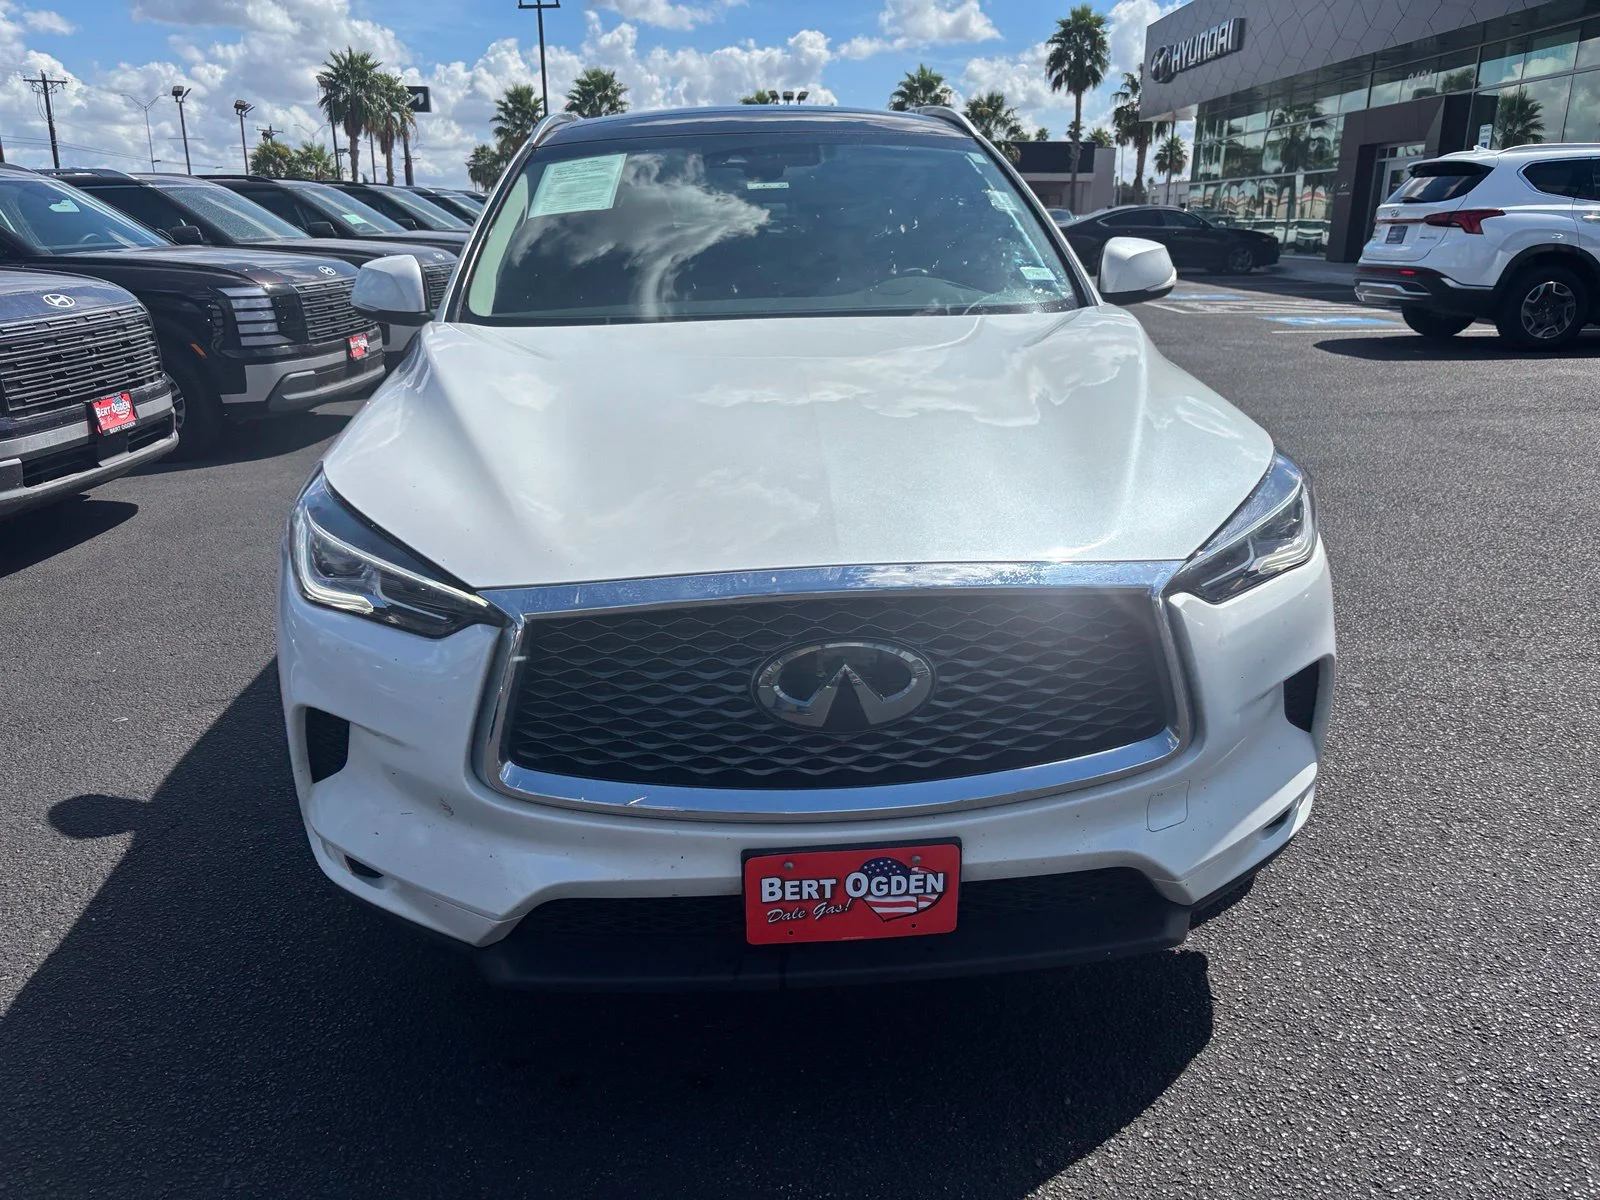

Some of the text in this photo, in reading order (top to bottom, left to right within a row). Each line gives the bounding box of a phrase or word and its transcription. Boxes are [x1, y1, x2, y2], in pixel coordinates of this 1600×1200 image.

[1171, 18, 1237, 73] HYUNDAI
[761, 871, 945, 903] BERT OGDEN
[767, 897, 853, 923] Dale Gas!
